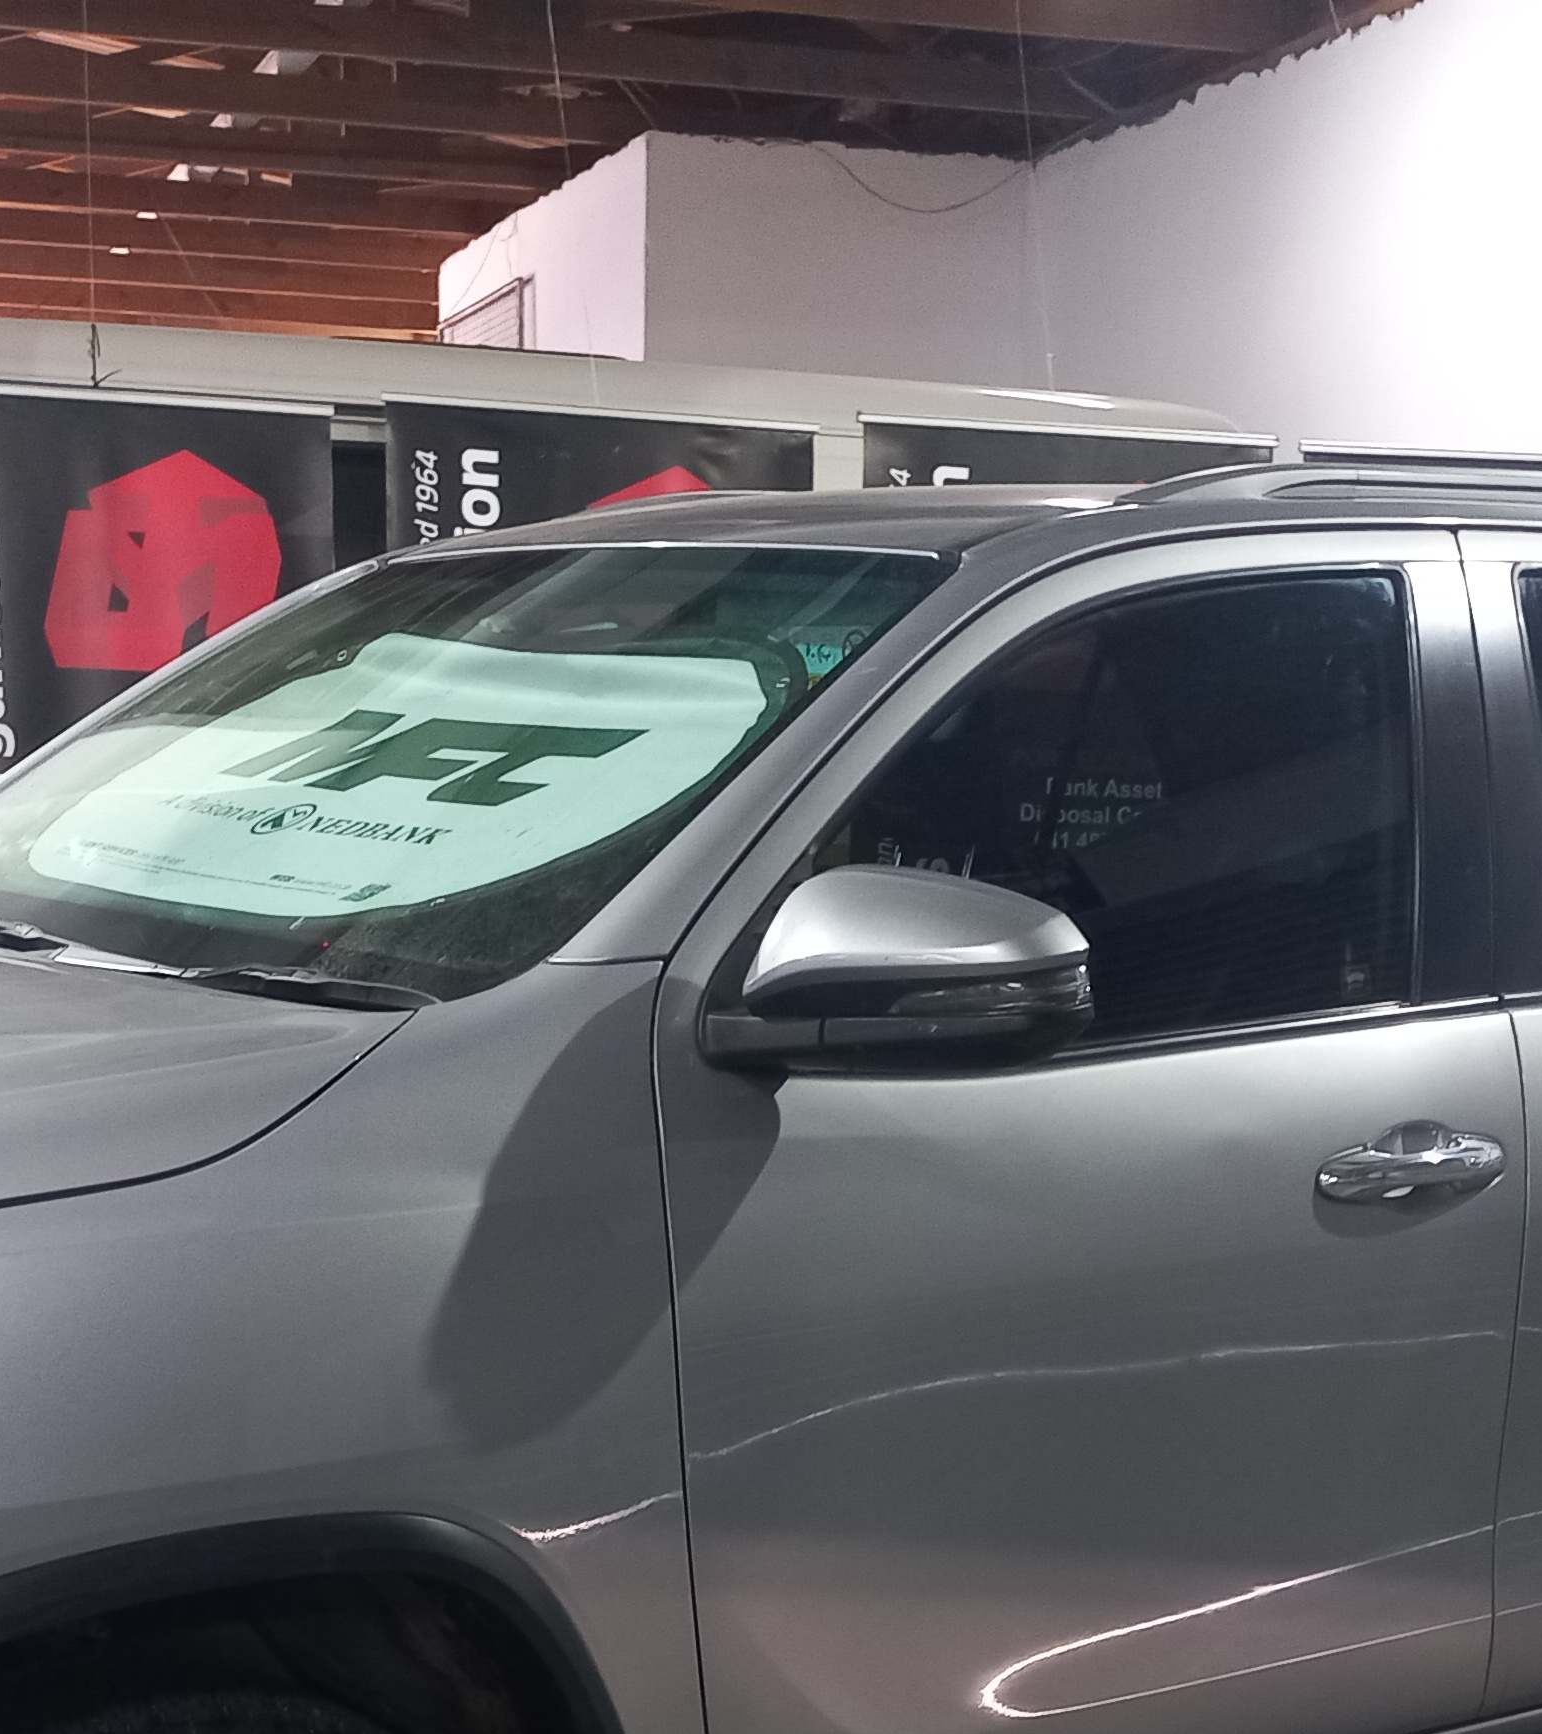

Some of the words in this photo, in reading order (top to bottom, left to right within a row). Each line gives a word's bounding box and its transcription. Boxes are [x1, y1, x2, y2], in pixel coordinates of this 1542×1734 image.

[414, 450, 439, 512] 1964
[1103, 778, 1163, 799] Asset
[296, 815, 453, 845] NEDBANK
